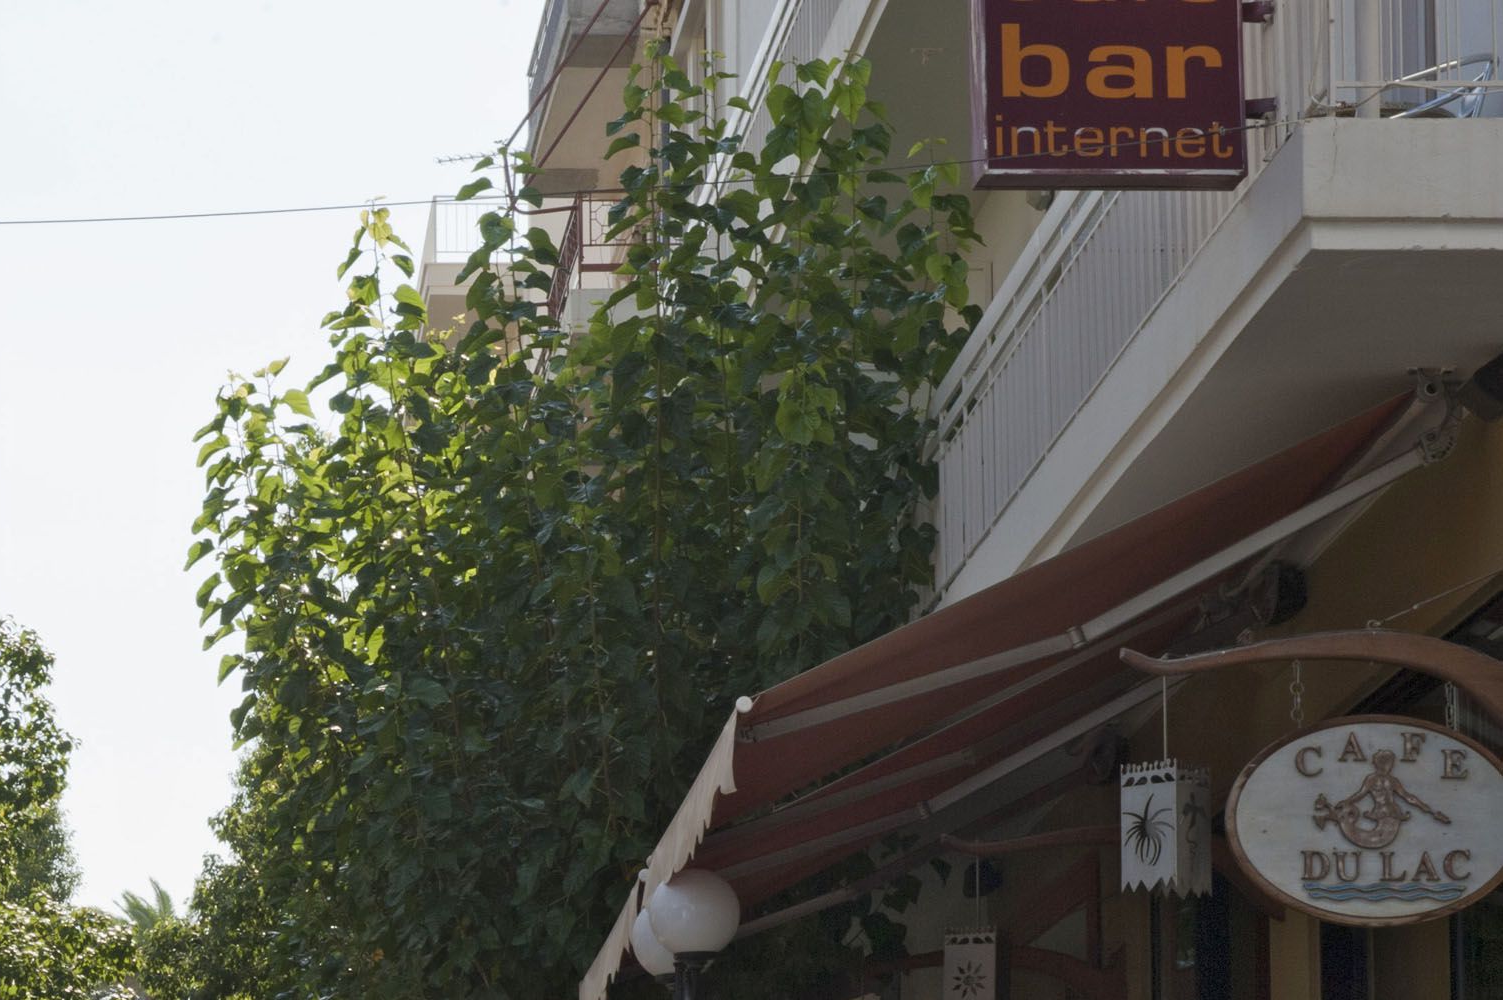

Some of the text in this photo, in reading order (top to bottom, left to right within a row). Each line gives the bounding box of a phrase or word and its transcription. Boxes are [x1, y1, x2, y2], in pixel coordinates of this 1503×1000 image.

[1001, 23, 1222, 99] bar
[994, 114, 1235, 160] internet
[1295, 731, 1470, 779] CAFE
[1300, 848, 1473, 884] DU LAC
